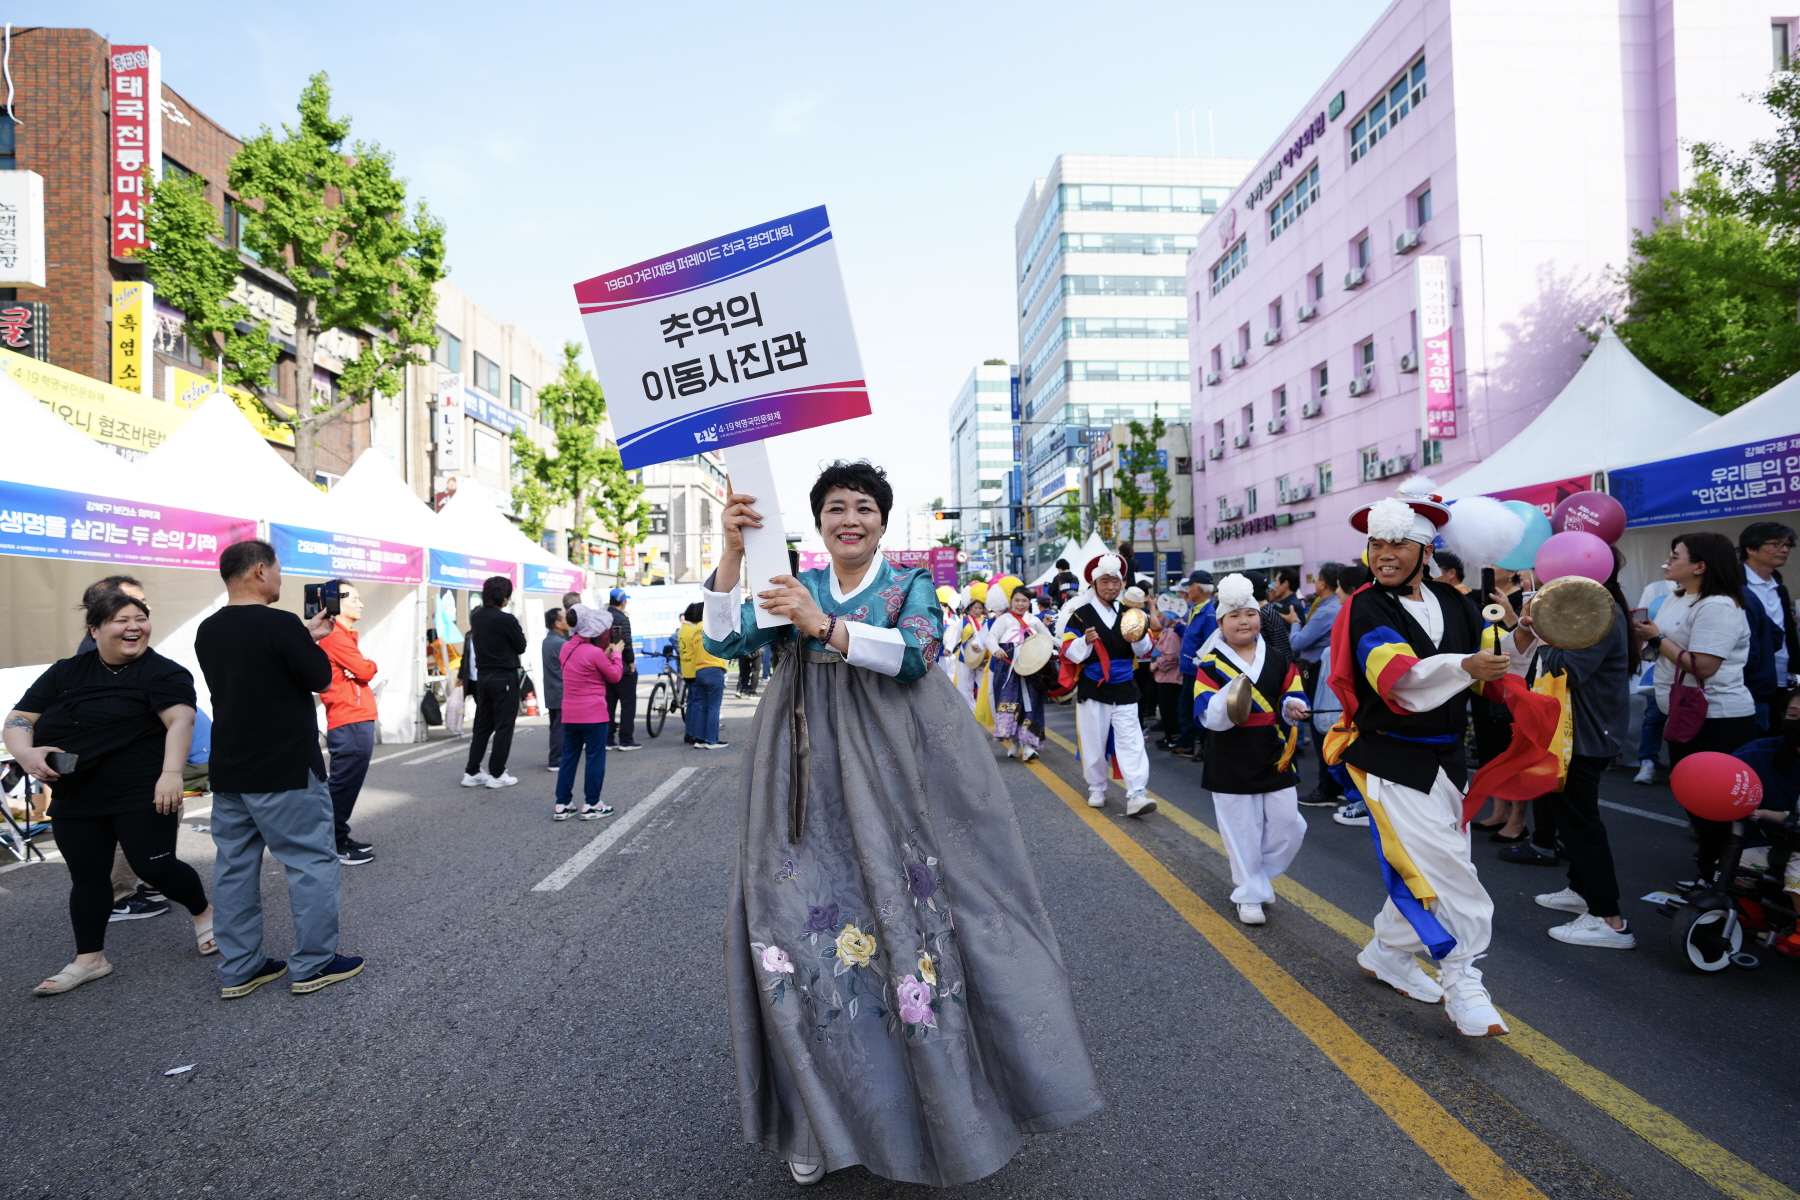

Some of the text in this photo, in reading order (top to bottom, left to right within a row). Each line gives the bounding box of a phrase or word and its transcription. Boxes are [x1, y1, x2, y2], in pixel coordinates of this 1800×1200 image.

[115, 76, 146, 245] 태국전통마사지
[604, 223, 794, 292] 1960 거리재현 퍼레이드 전국 경연대회
[659, 291, 764, 349] 추억의
[117, 313, 139, 380] 흑염소
[641, 330, 809, 402] 이동사진관
[98, 414, 167, 449] 협조바랍
[1744, 439, 1788, 458] 강북구청
[1711, 458, 1782, 485] 우리들의
[0, 509, 218, 554] 생명을 살리는 두 손의 기적
[901, 551, 931, 562] 2024
